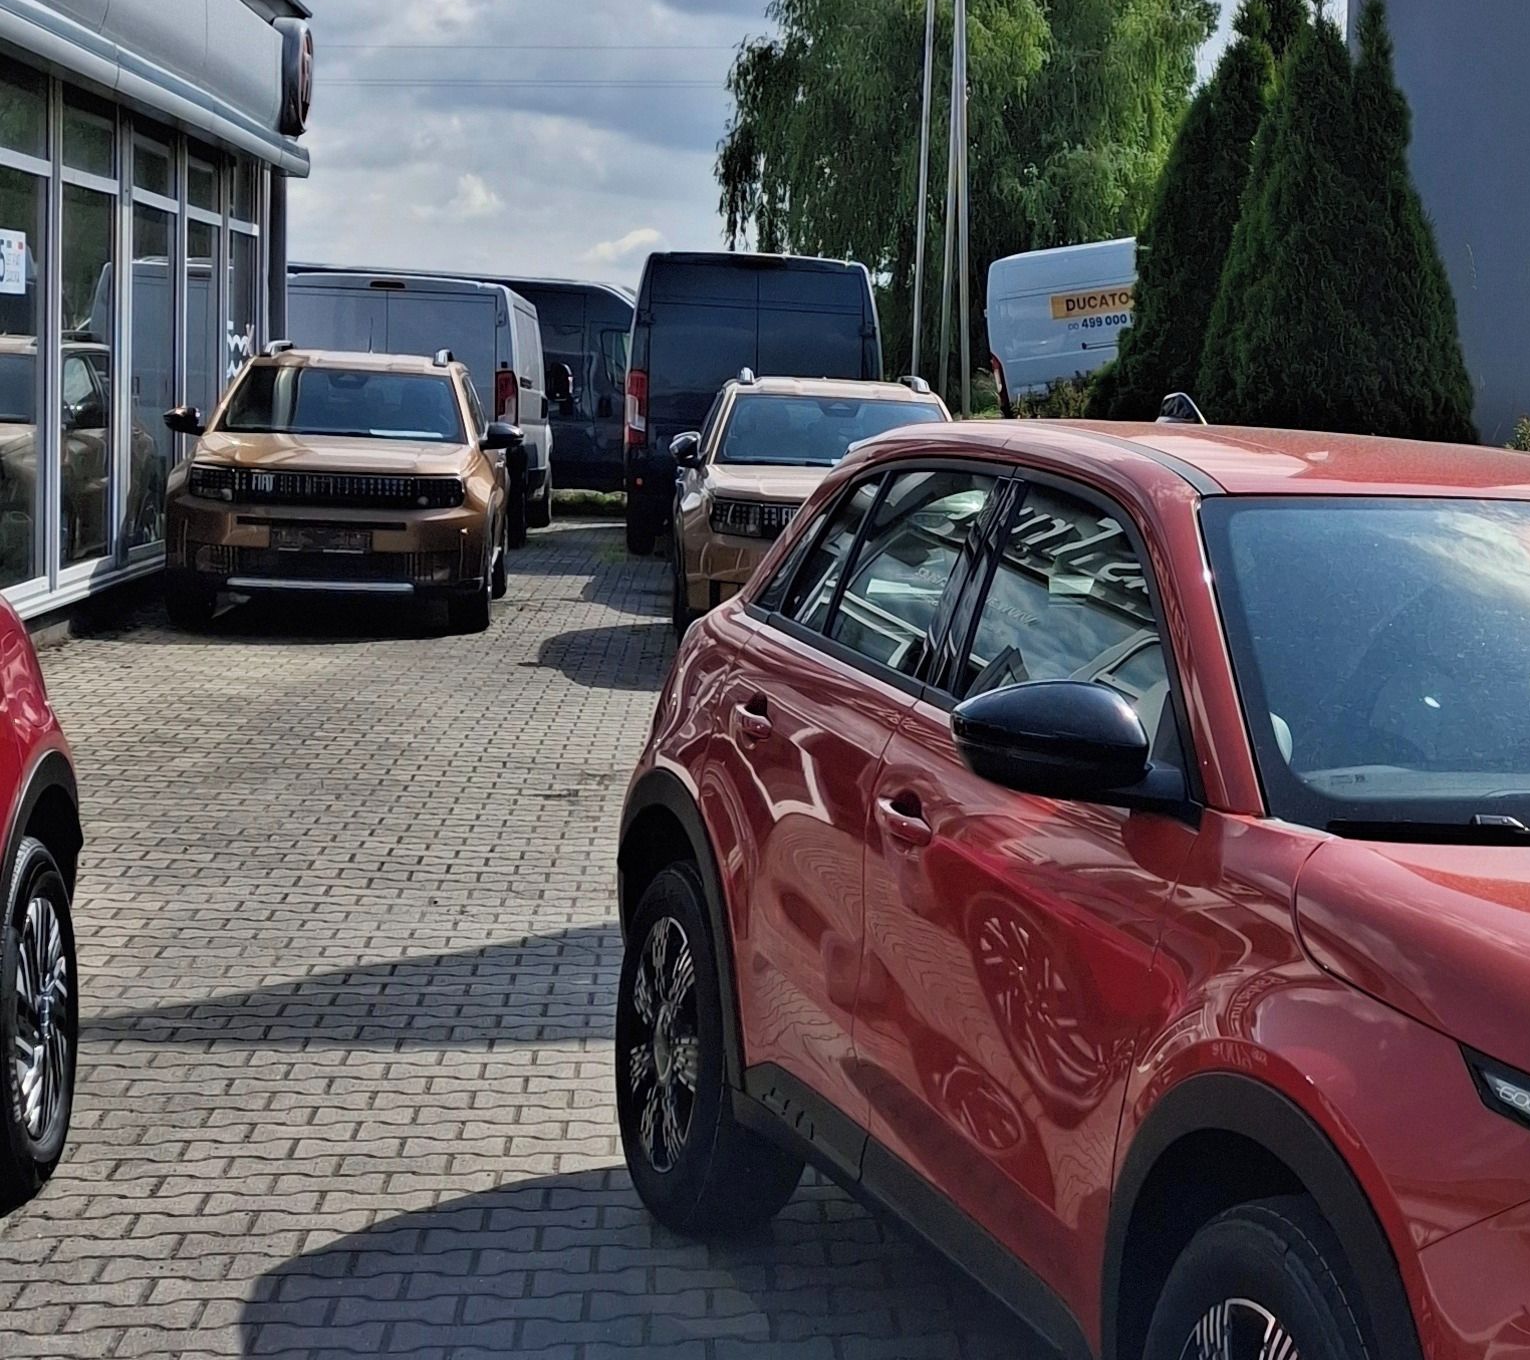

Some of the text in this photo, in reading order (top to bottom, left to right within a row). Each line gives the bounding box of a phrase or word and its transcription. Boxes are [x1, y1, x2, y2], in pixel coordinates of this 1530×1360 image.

[1065, 292, 1130, 312] DUCATO
[1081, 316, 1103, 329] 499
[1104, 313, 1127, 326] 000
[251, 474, 276, 492] FIAT
